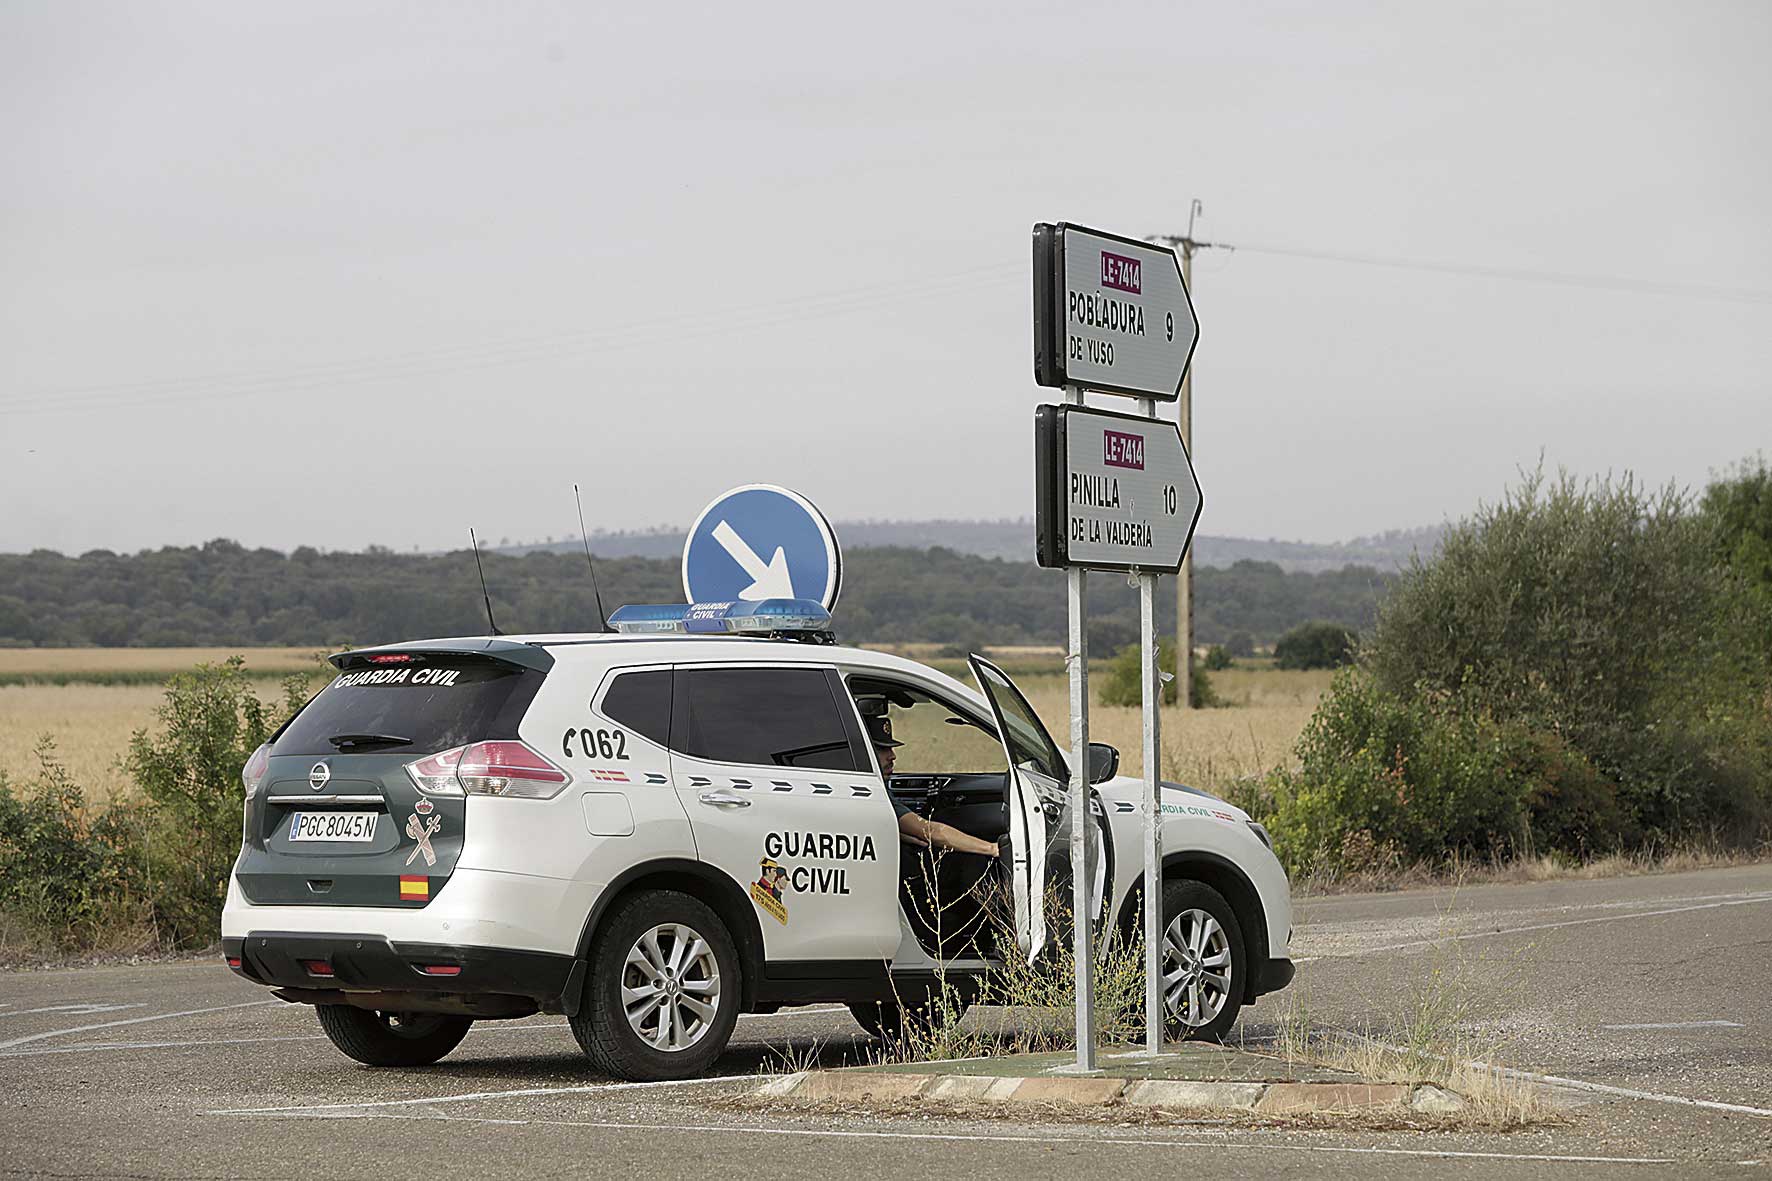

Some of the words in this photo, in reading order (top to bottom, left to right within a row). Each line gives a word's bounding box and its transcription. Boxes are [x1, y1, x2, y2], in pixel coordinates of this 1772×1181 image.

[1102, 256, 1140, 289] LE-7414
[1069, 291, 1145, 337] POBLADURA
[1166, 311, 1173, 342] 9
[1070, 335, 1083, 360] DE
[1087, 338, 1114, 366] YUSO
[1105, 435, 1143, 465] LE-7414
[1071, 472, 1120, 509] PINILLA
[1163, 485, 1177, 515] 10
[1071, 517, 1084, 541] DE
[1089, 520, 1101, 543] LA
[1106, 519, 1153, 548] VALDERÍA
[690, 602, 730, 611] GUARDIA
[693, 610, 715, 619] CIVIL
[334, 668, 411, 689] GUARDIA
[411, 668, 460, 687] CIVIL
[580, 728, 630, 760] 062
[1187, 806, 1211, 817] CIVIL
[765, 831, 877, 861] GUARDIA
[791, 866, 850, 895] CIVIL
